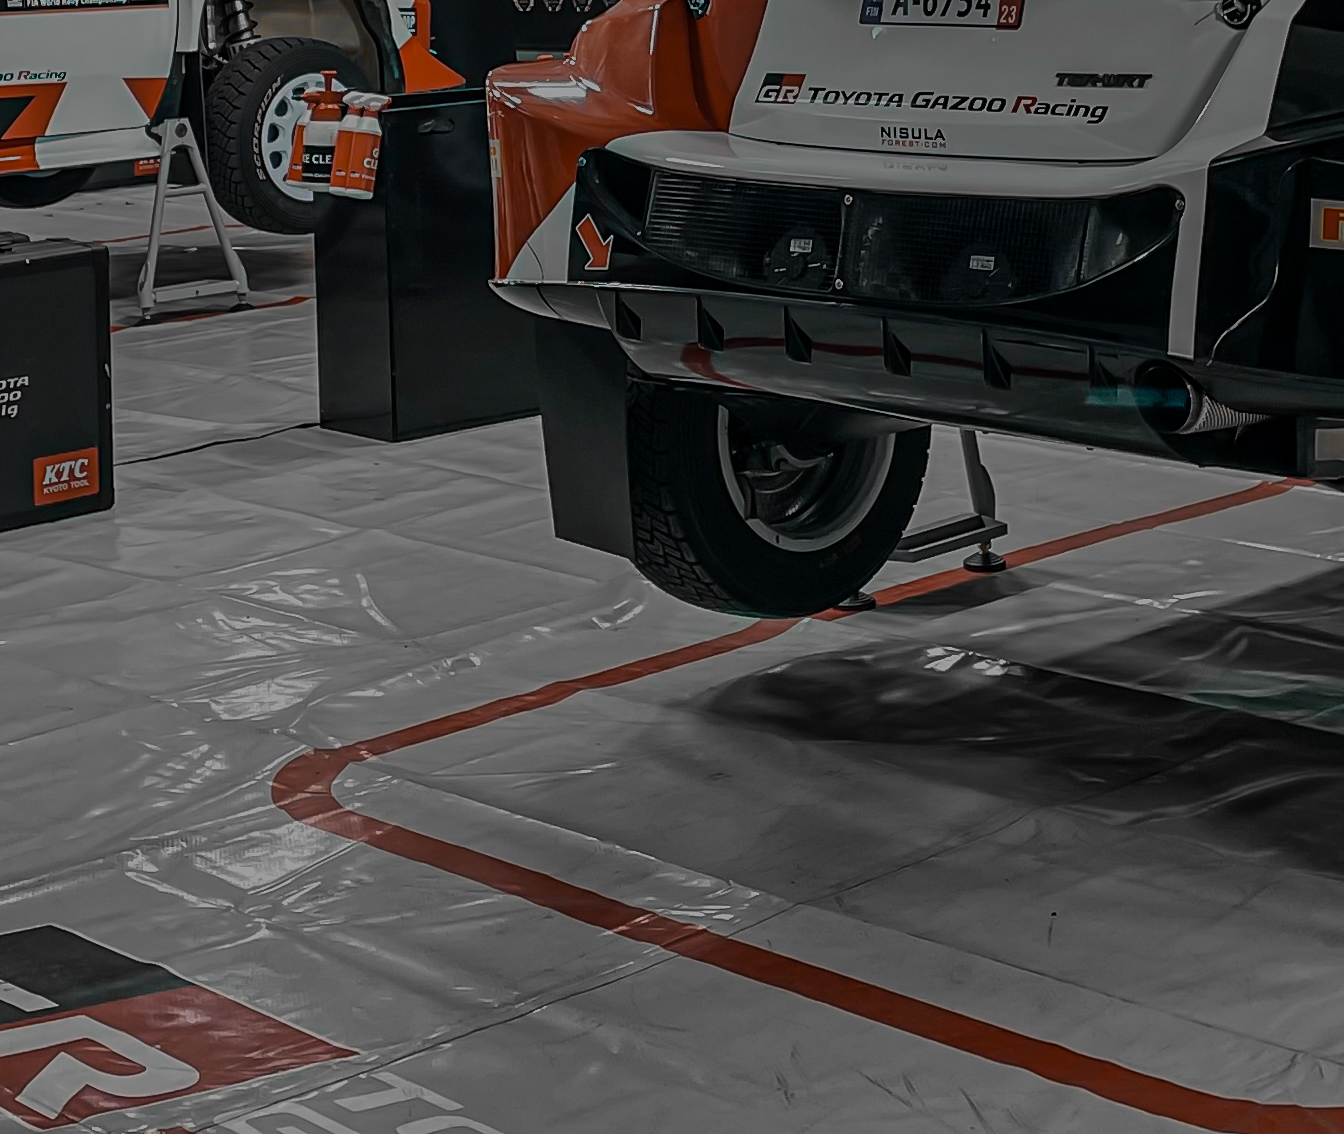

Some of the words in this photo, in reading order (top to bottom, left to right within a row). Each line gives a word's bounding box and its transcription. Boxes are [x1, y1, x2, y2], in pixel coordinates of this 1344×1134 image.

[998, 4, 1018, 25] 23
[16, 69, 68, 82] Racing
[756, 83, 802, 105] GR
[807, 86, 905, 109] TOYOTA
[909, 90, 1008, 114] GAZOO
[1010, 94, 1110, 125] Racing
[879, 125, 947, 142] NISULA
[42, 458, 89, 486] KTC
[43, 482, 69, 495] KYOTO
[70, 478, 90, 490] TOOL
